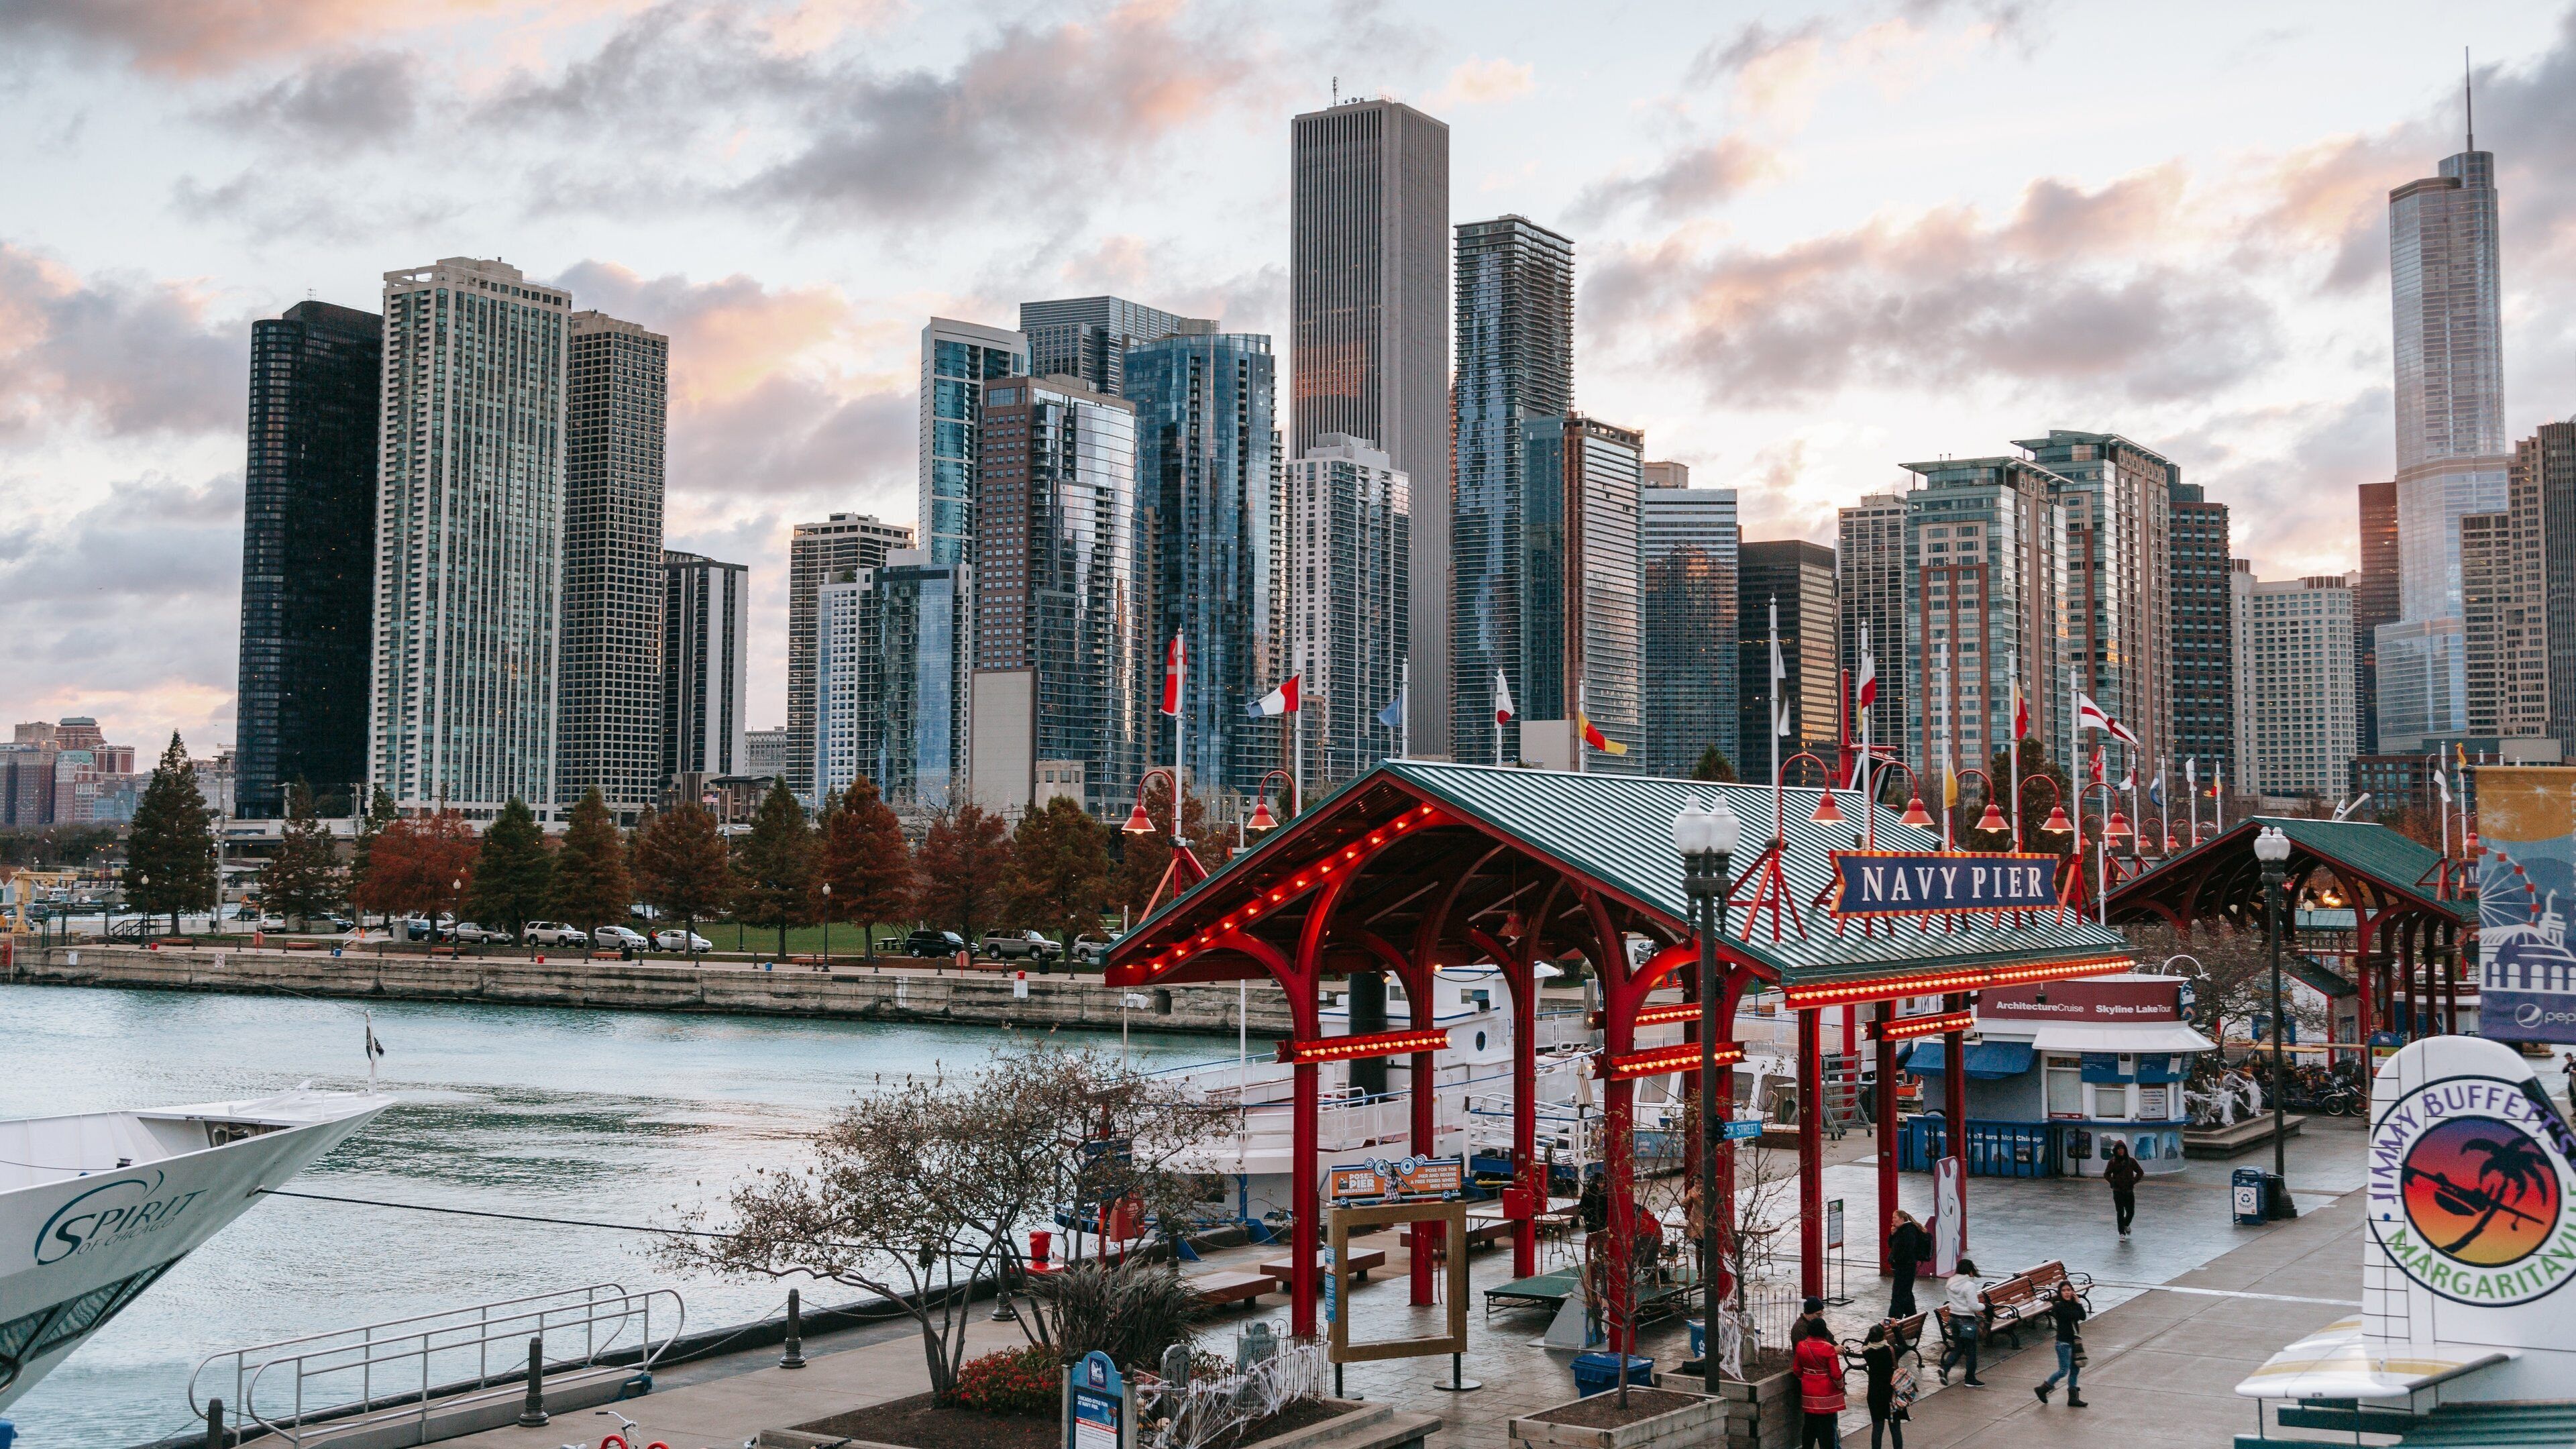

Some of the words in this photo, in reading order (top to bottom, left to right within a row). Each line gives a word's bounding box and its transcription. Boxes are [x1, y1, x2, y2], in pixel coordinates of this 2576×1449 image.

[1862, 867, 1957, 902] NAVY
[1971, 867, 2043, 898] PIER
[1996, 1001, 2084, 1013] ArchitectureCruise
[2096, 1004, 2134, 1016] Skyline
[2136, 1004, 2172, 1014] LakeTour
[1737, 1124, 1758, 1135] STREET
[2371, 1105, 2420, 1205] JIMMY
[2422, 1084, 2576, 1155] BUFFETT'S
[1349, 1179, 1375, 1189] PIER
[38, 1189, 209, 1265] SPIRIT
[77, 1238, 103, 1254] OF
[105, 1217, 175, 1247] CHICAGO
[1078, 1395, 1101, 1405] CHICAGO-STYLE
